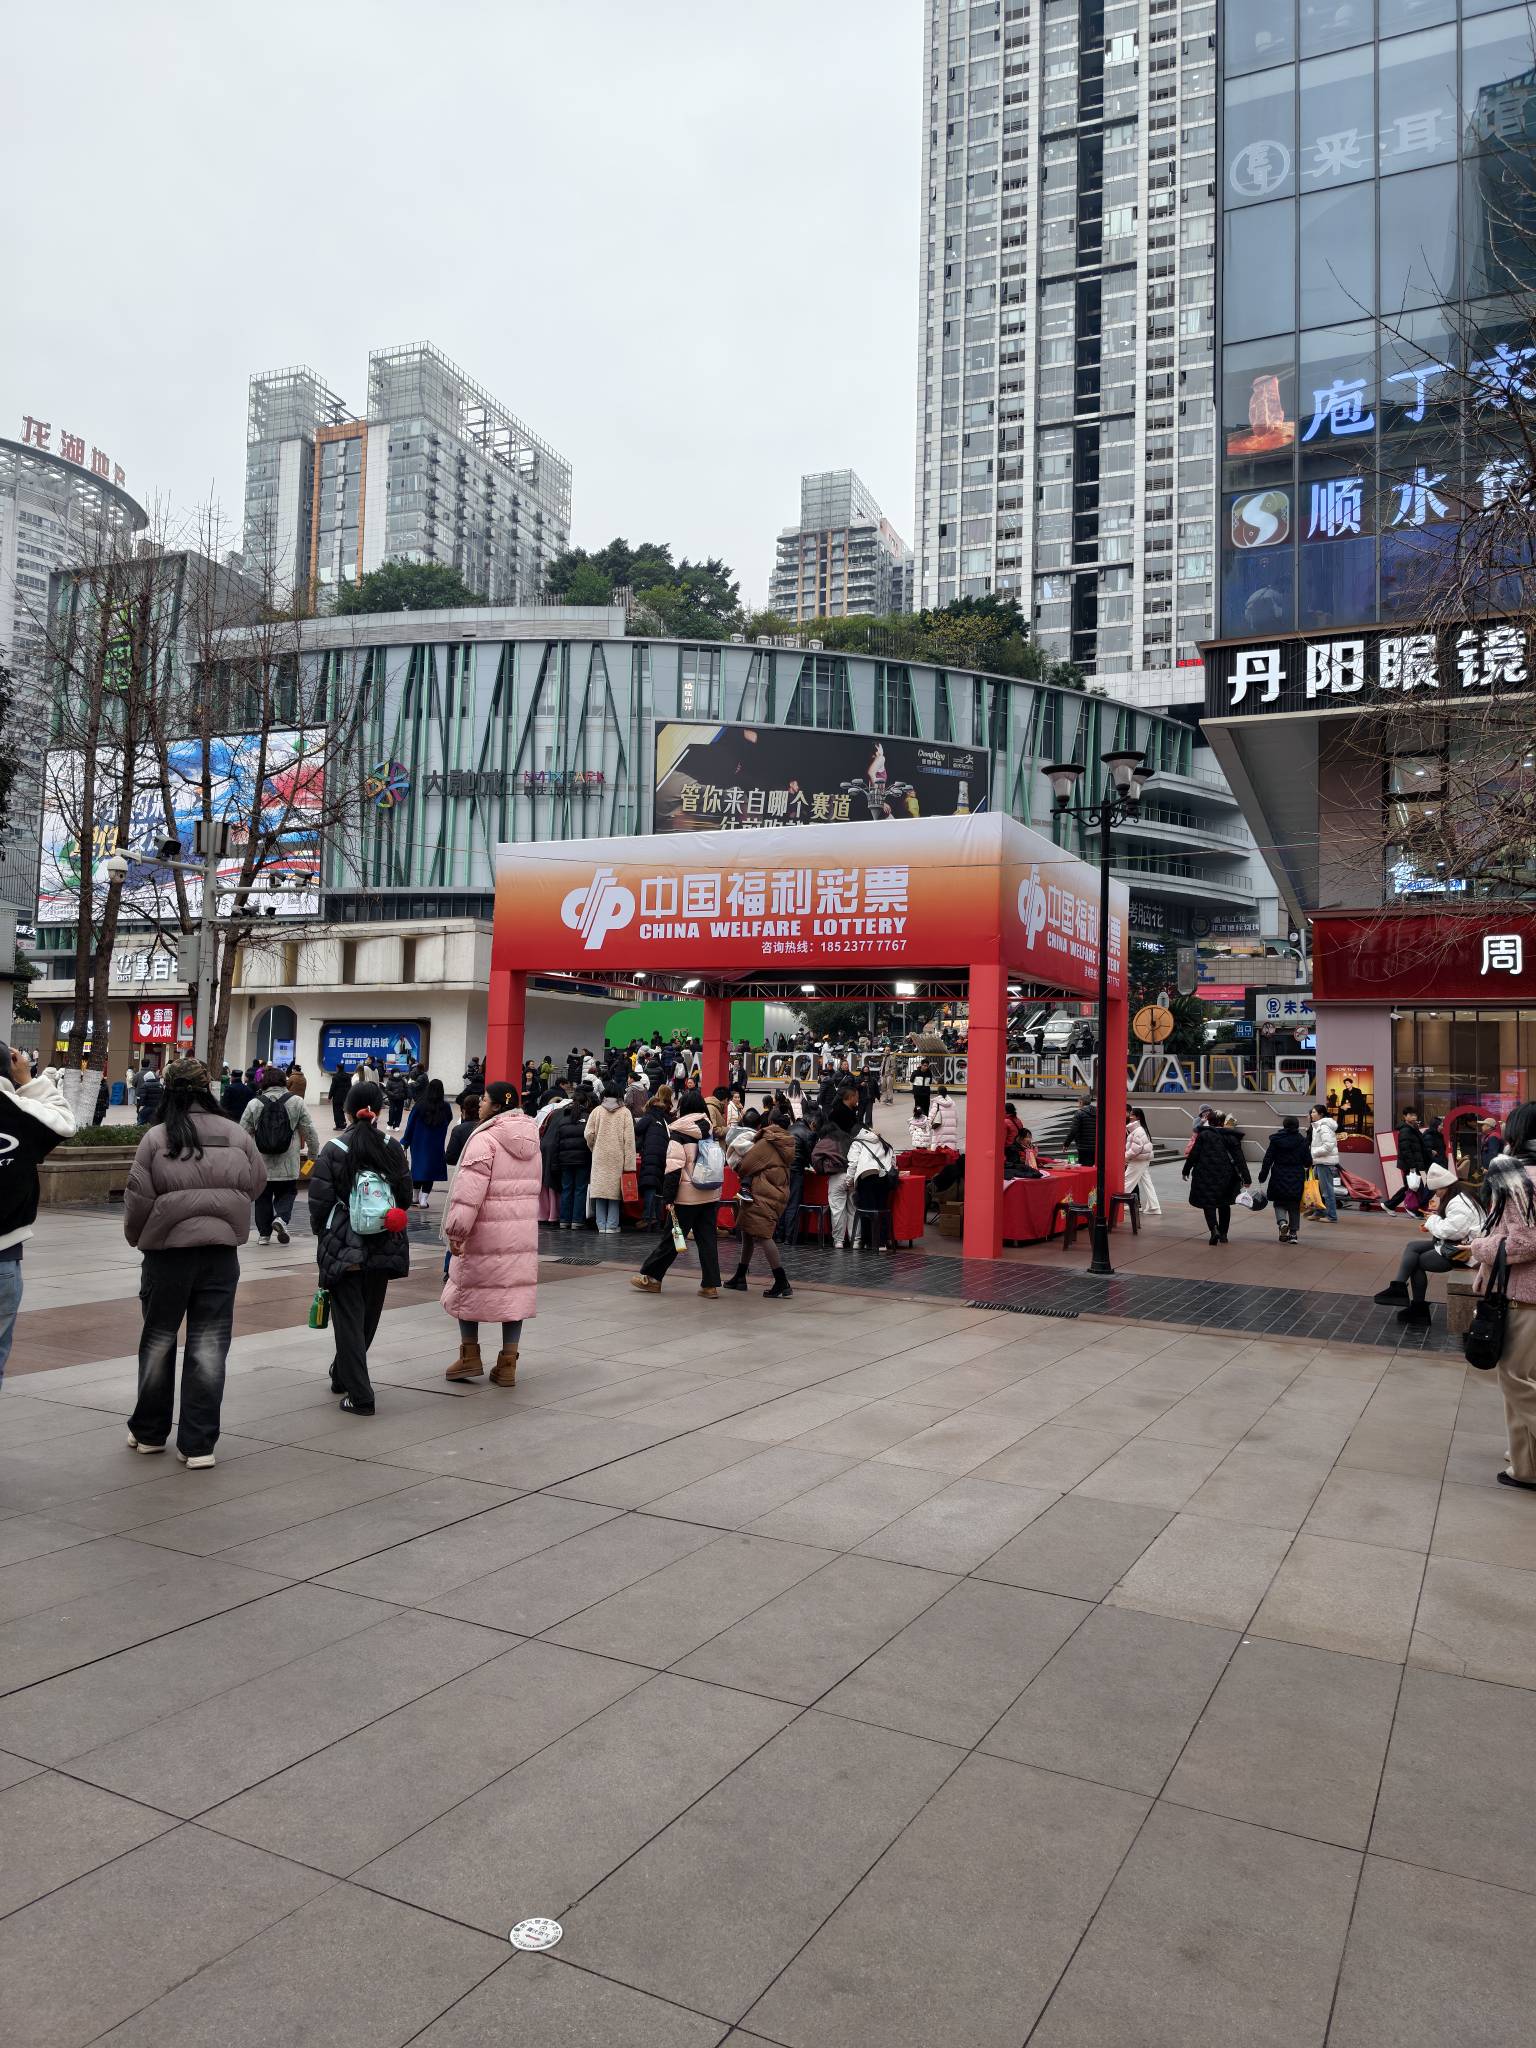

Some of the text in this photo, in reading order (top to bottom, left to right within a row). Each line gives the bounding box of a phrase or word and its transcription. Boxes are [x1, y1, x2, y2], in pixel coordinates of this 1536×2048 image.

[1227, 625, 1528, 705] 丹阳眼镜
[680, 783, 852, 821] 管你来自哪个赛道
[640, 864, 909, 919] 中国福利彩票
[640, 917, 907, 940] CHINA WELFARE LOTTERY
[1048, 884, 1121, 957] 中国福利票
[821, 941, 841, 953] 185
[844, 940, 873, 952] 2377
[876, 939, 907, 951] 7767
[1047, 931, 1067, 954] CHINA
[1070, 941, 1096, 965] WELFARE
[1480, 934, 1522, 976] 周
[133, 955, 178, 981] 重百
[153, 1008, 173, 1022] 蜜雪
[152, 1024, 172, 1038] 冰城
[1236, 1024, 1252, 1033] 出口
[328, 1037, 389, 1048] 重百手机数码城
